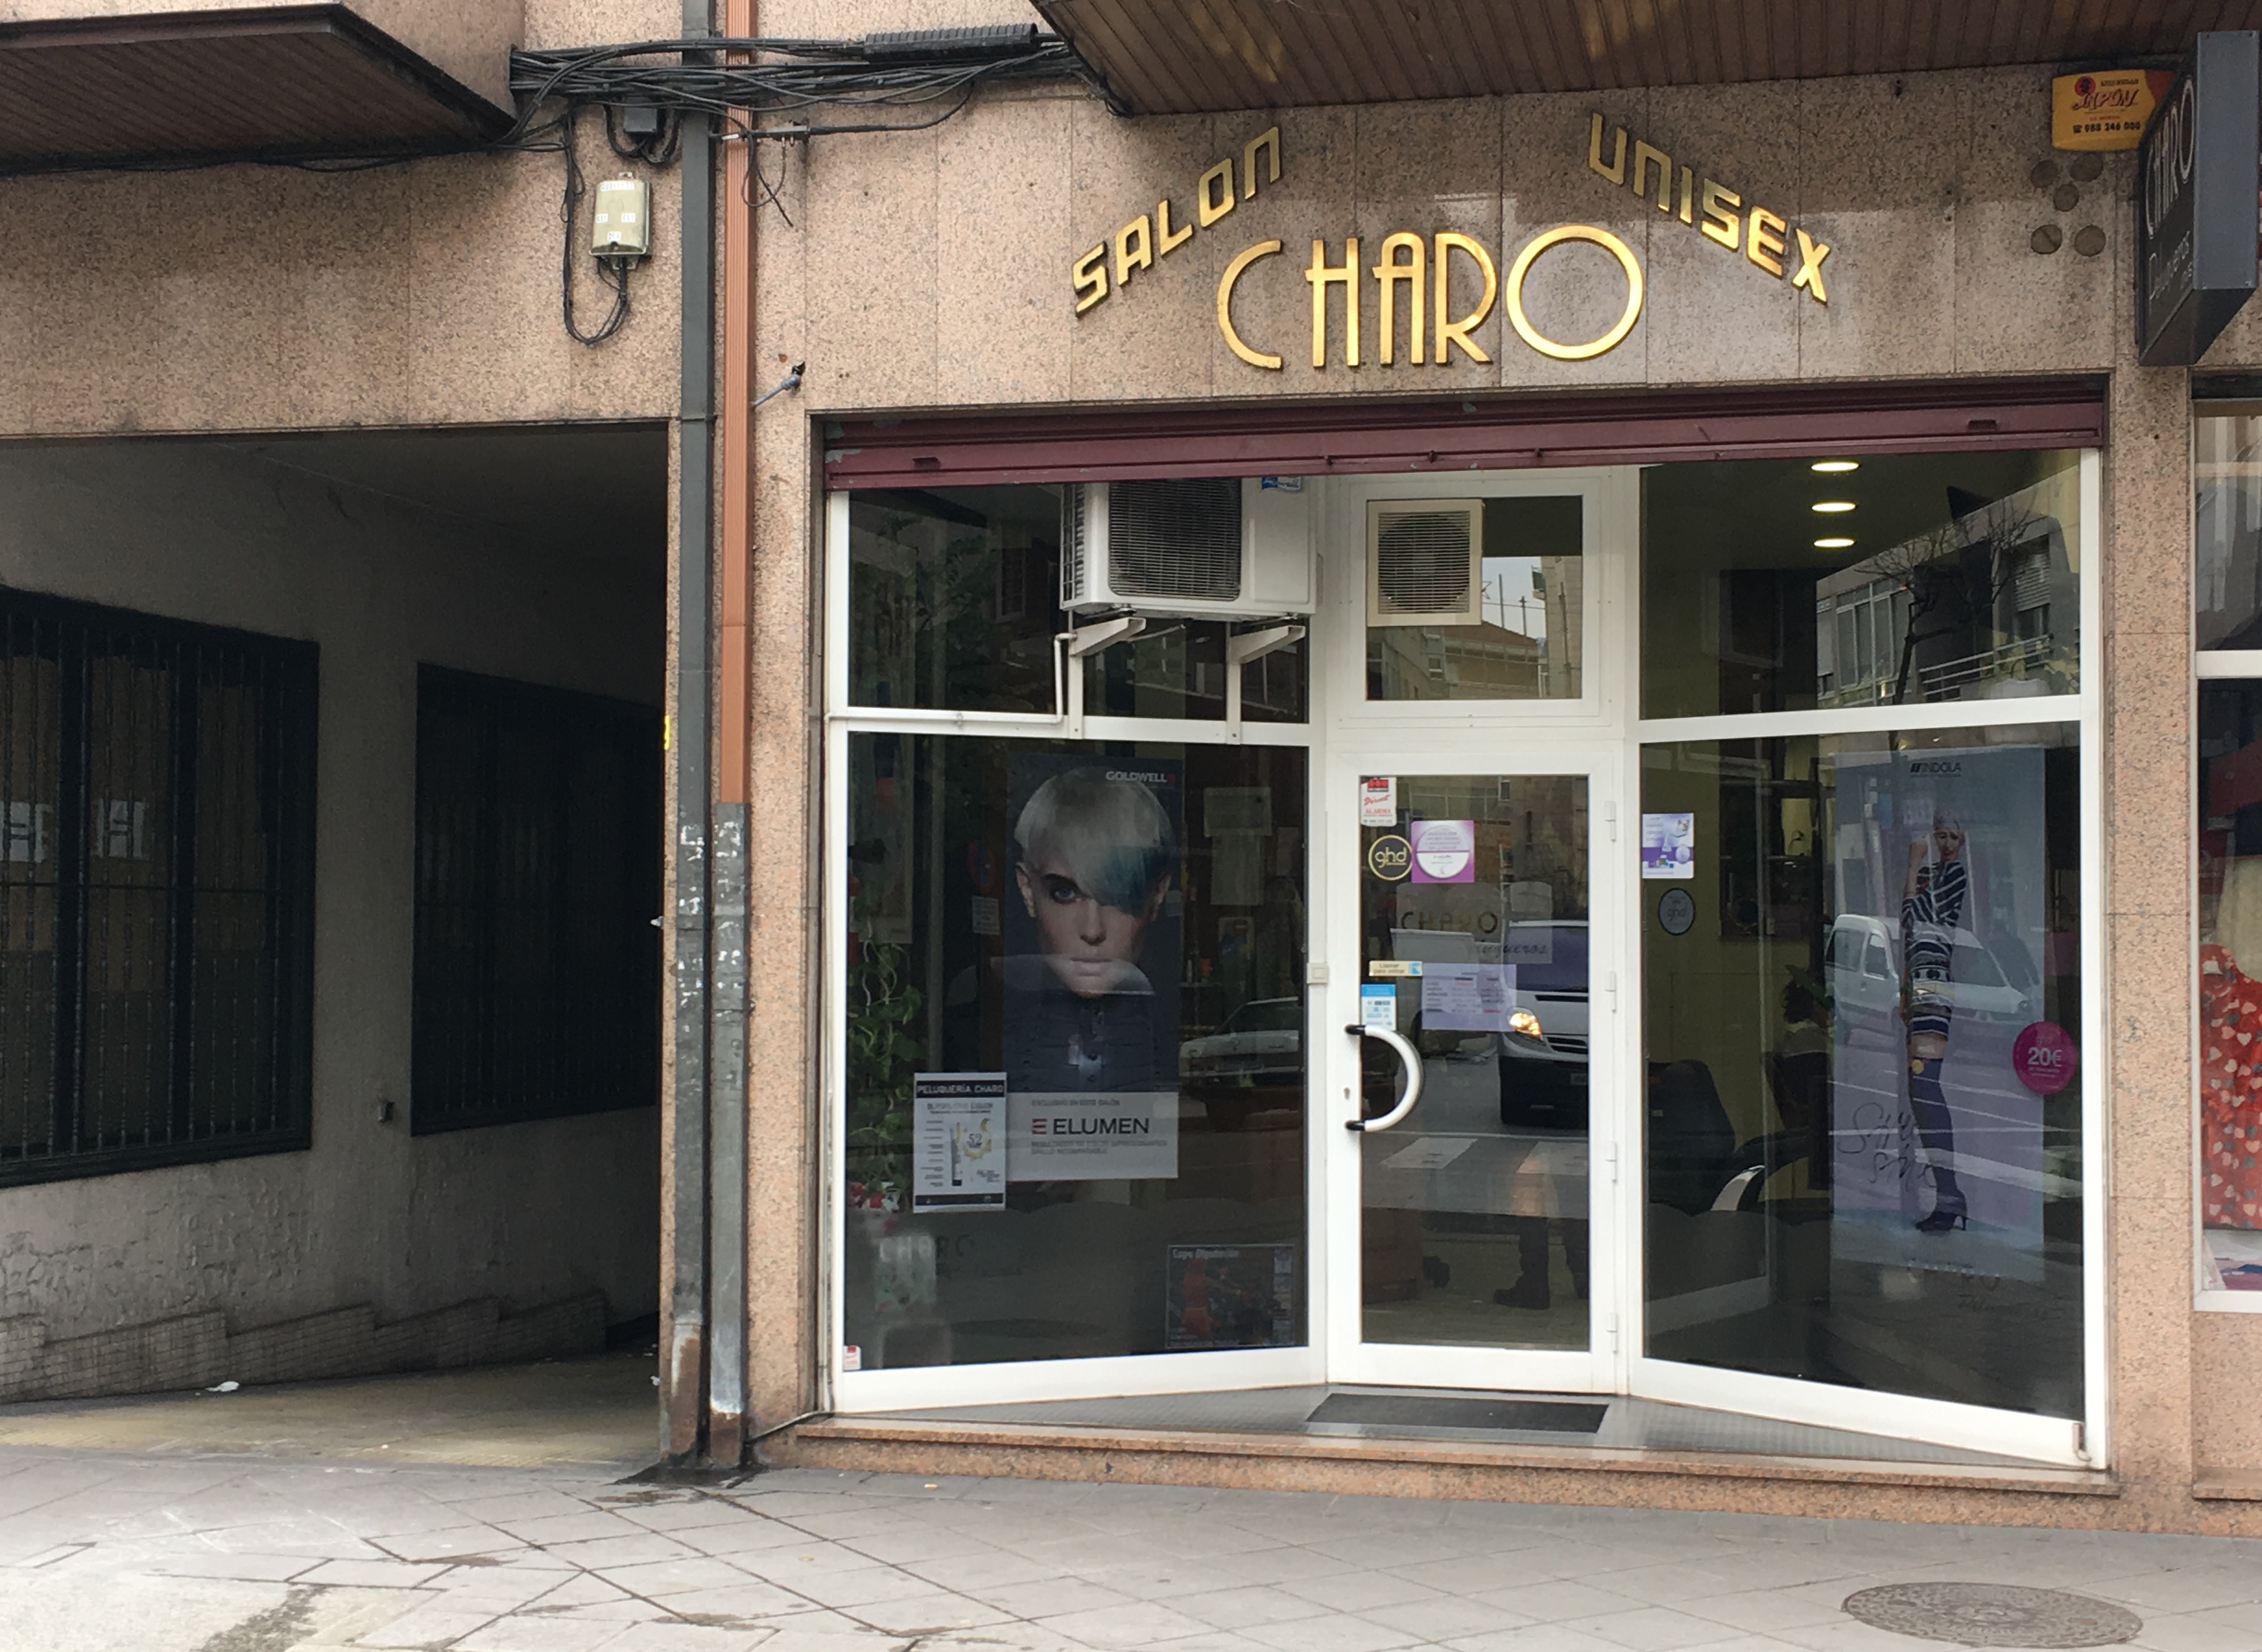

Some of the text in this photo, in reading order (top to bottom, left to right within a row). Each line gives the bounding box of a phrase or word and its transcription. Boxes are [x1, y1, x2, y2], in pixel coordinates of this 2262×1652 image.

[2145, 74, 2195, 240] CHARO
[1071, 126, 1281, 317] SALON
[1589, 112, 1830, 306] UNISEX
[1216, 225, 1644, 370] CHARO
[1106, 771, 1168, 783] GOLDWELL
[1374, 847, 1407, 868] ghd
[2028, 1047, 2063, 1067] 20€
[1053, 1117, 1149, 1135] ELUMEN
